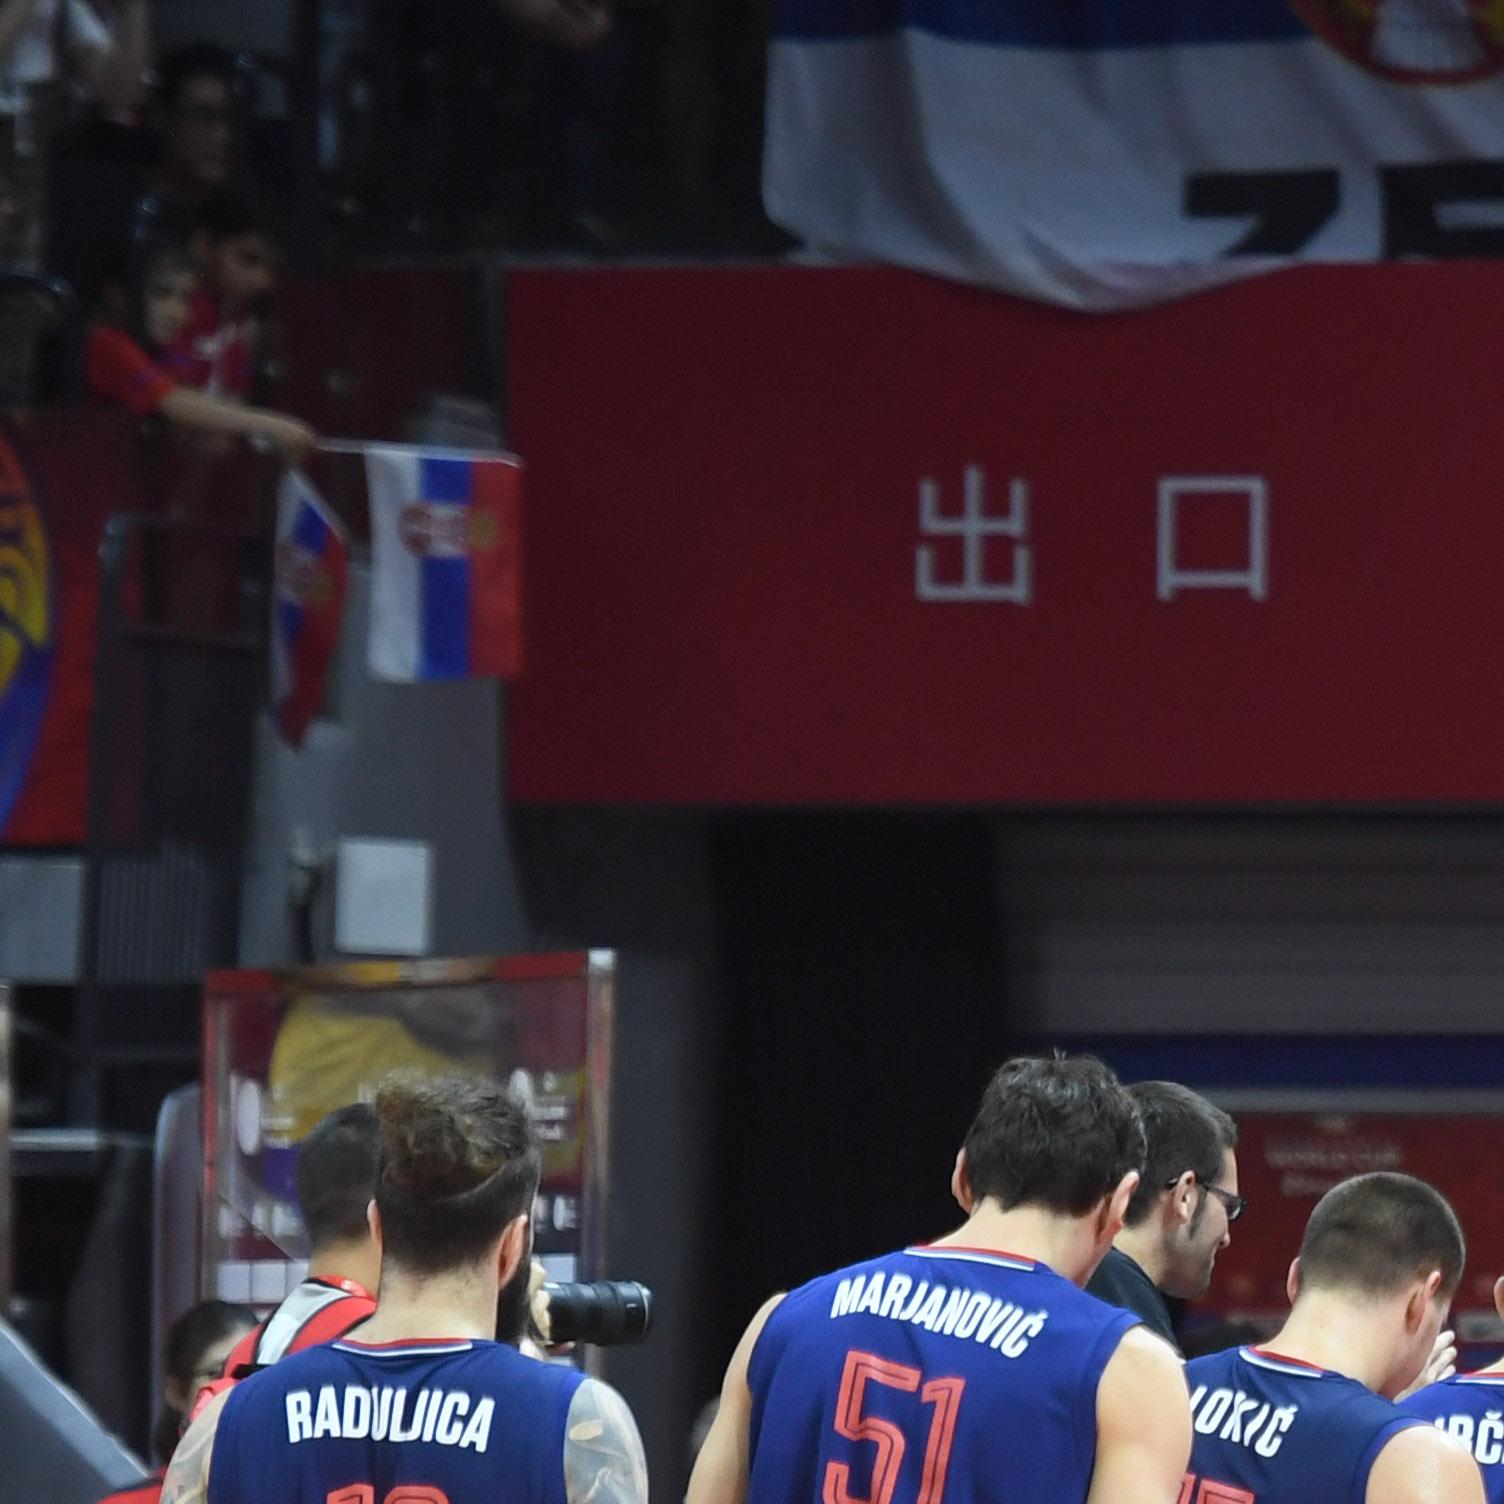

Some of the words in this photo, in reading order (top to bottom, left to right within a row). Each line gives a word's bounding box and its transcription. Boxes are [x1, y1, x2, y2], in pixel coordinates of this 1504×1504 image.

[914, 464, 1269, 606] 出口
[829, 1270, 1050, 1359] MARJANOVIĆ
[286, 1384, 496, 1453] RADULJICA
